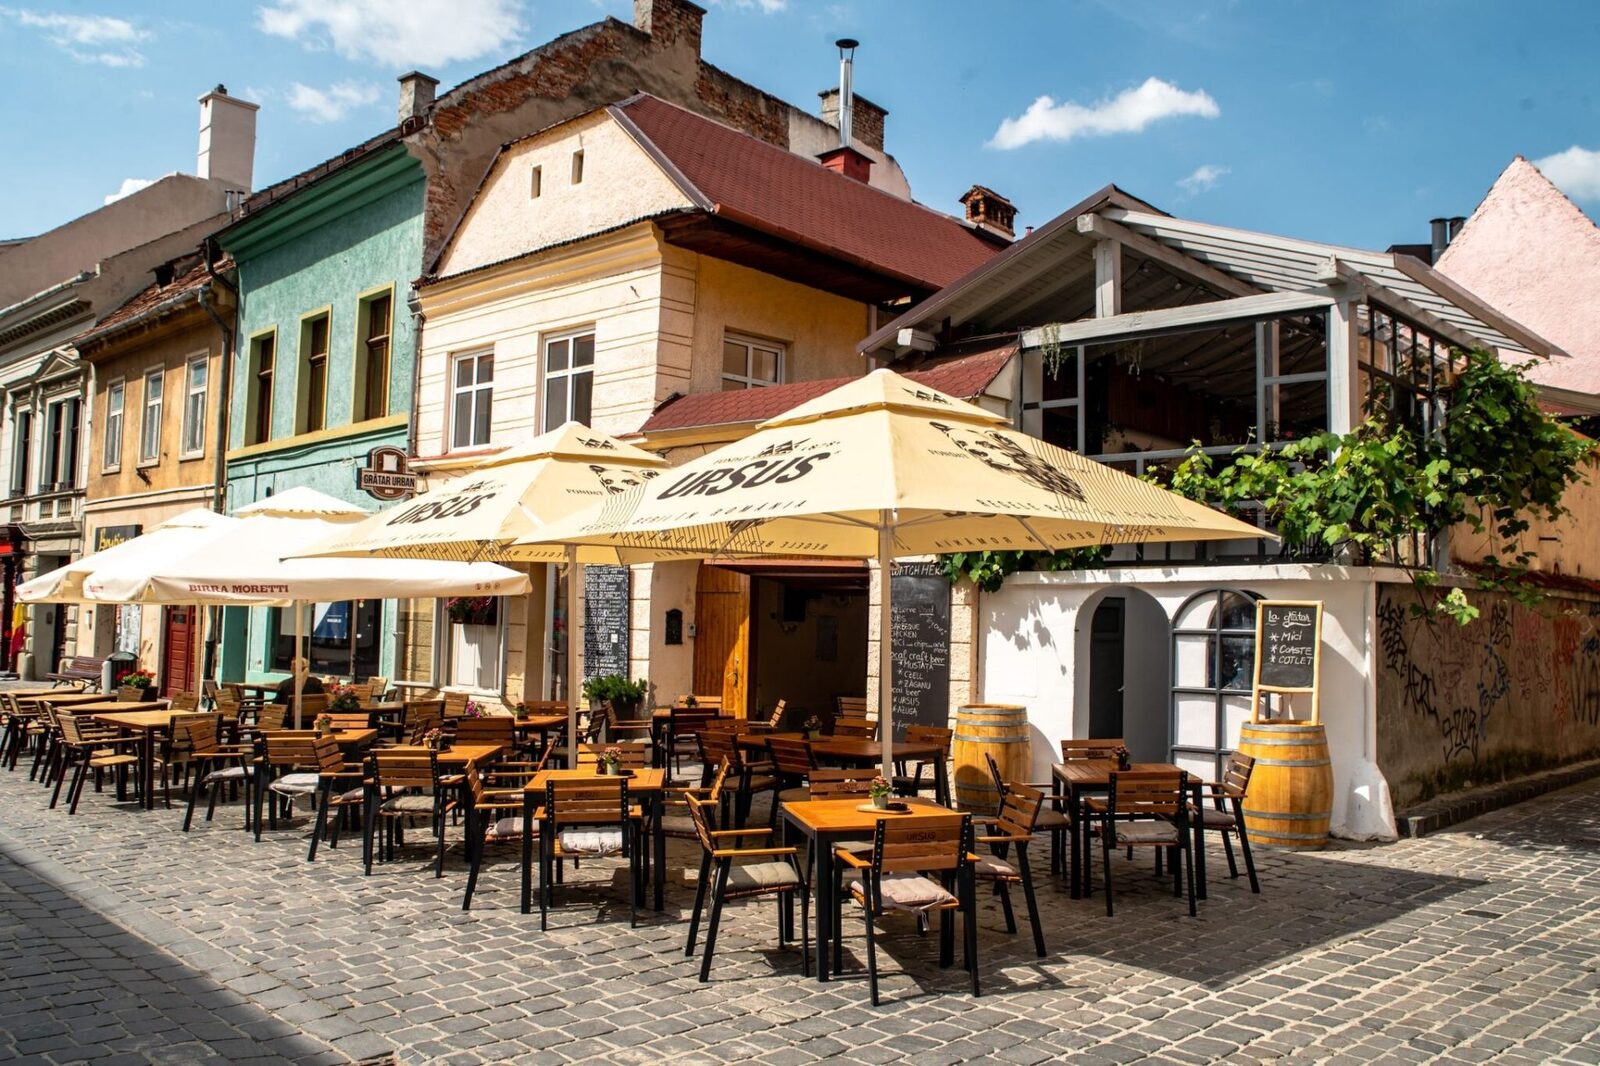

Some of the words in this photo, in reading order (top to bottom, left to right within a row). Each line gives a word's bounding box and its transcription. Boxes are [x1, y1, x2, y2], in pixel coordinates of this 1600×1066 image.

[391, 476, 415, 488] URBAN
[657, 452, 831, 500] URSUS
[386, 492, 497, 526] URSUS
[188, 584, 228, 593] BIRRA
[232, 584, 289, 593] MORETTI
[1268, 609, 1280, 623] La
[1280, 631, 1303, 642] Mici
[908, 650, 929, 662] craft
[1278, 656, 1314, 666] COTLET
[906, 831, 936, 841] URSUS
